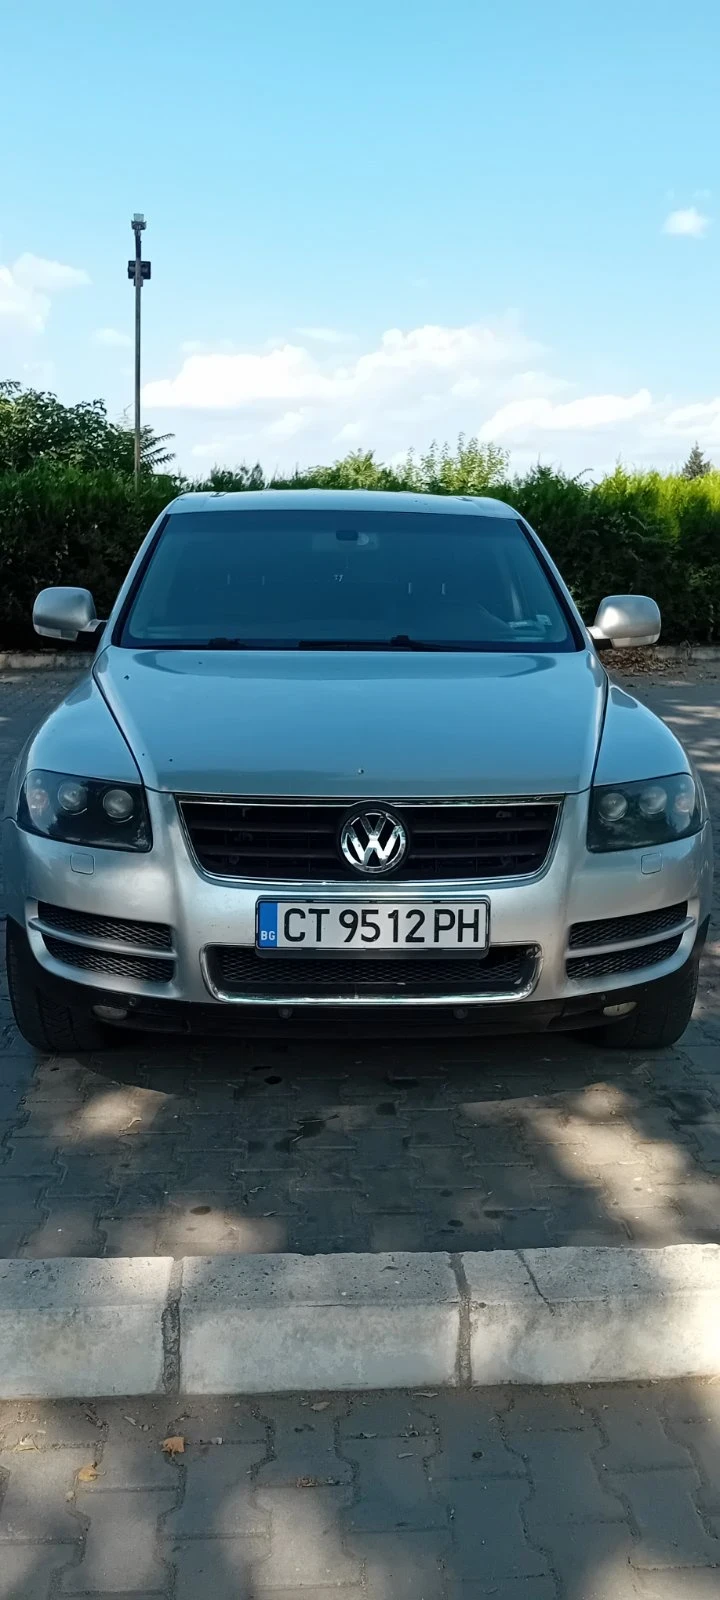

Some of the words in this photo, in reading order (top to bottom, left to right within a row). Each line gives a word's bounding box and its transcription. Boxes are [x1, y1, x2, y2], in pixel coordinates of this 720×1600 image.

[342, 811, 405, 872] VW
[260, 930, 276, 941] BG
[284, 908, 330, 942] CT
[338, 909, 426, 943] 9512
[433, 908, 480, 943] PH
